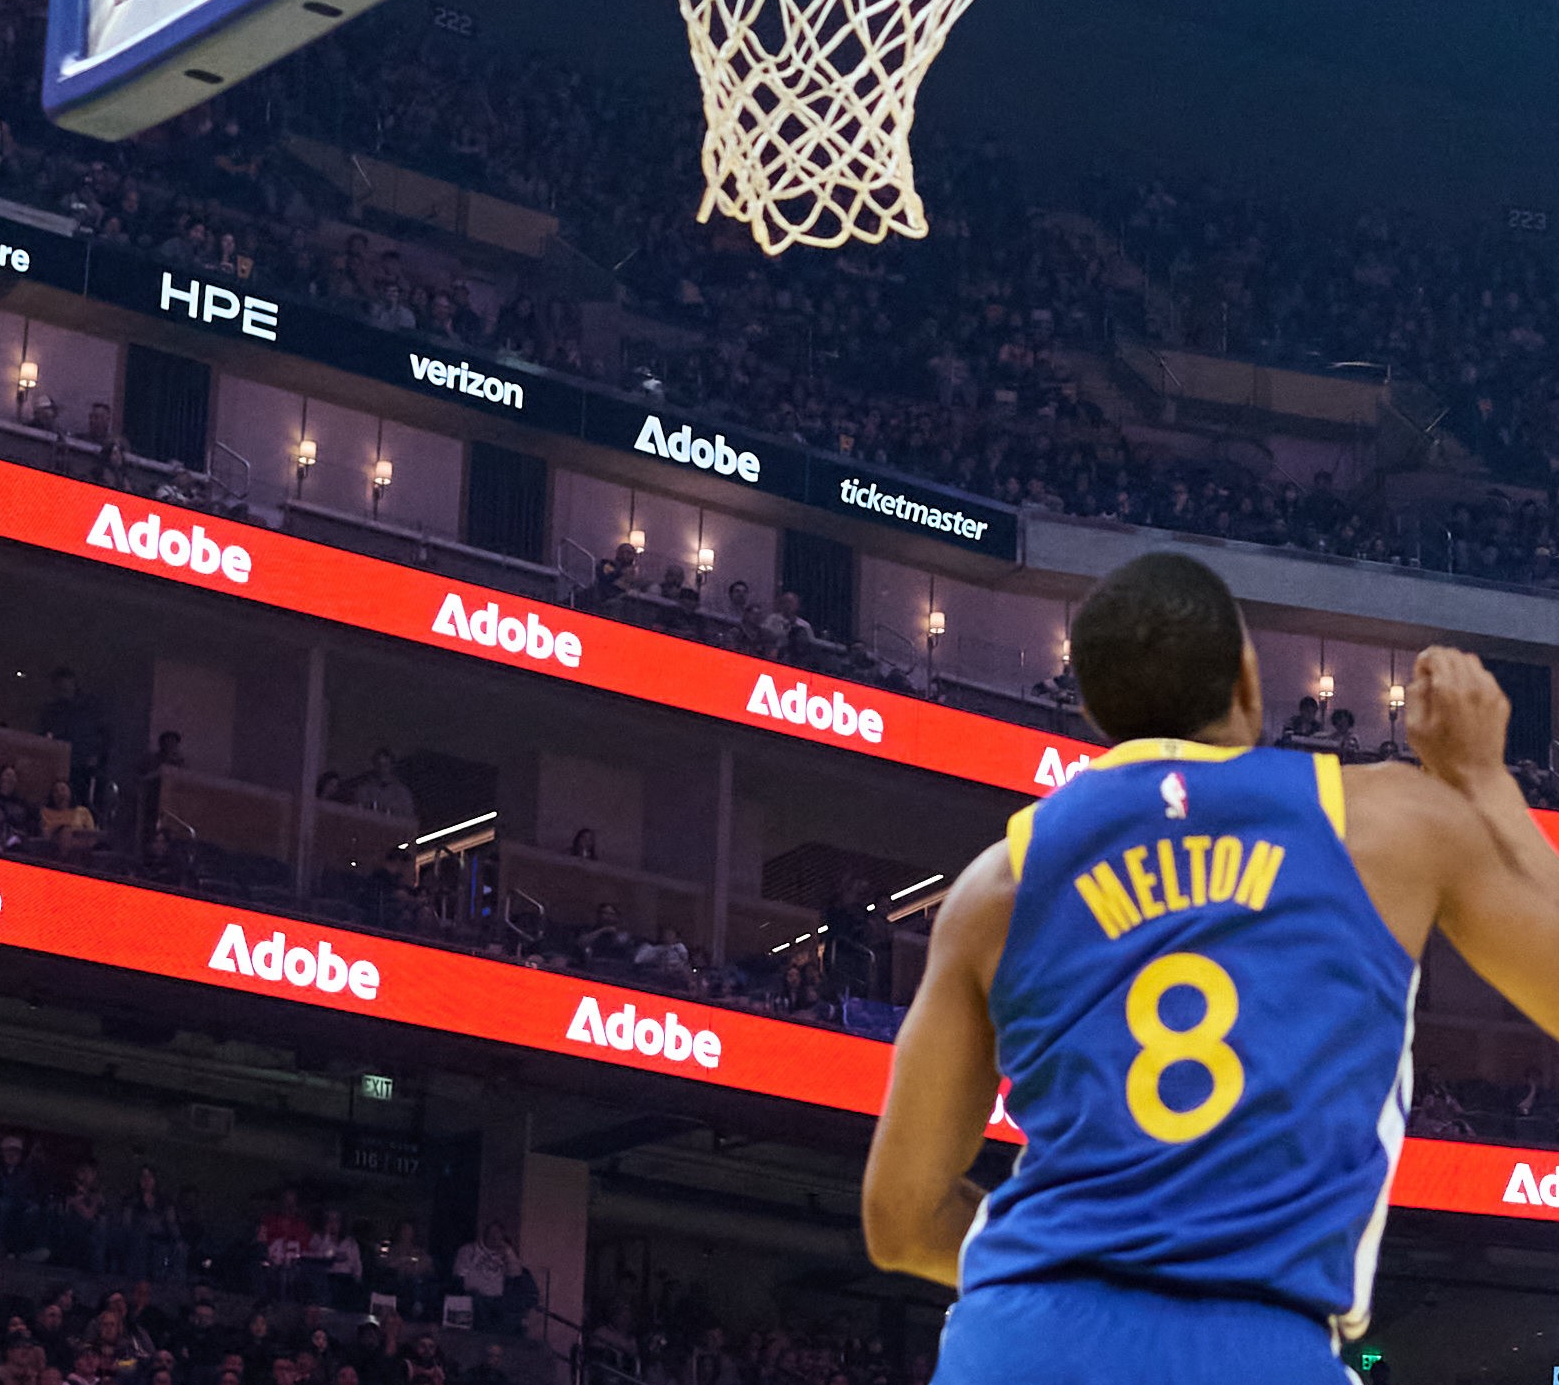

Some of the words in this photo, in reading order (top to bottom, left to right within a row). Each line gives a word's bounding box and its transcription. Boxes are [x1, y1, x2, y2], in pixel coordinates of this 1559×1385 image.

[160, 272, 279, 342] HPE
[409, 353, 524, 410] verizon
[634, 415, 760, 482] Adobe
[86, 503, 252, 583] Adobe
[840, 477, 988, 542] ticketmaster
[431, 593, 583, 667] Adobe
[746, 674, 884, 743] Adobe
[1074, 835, 1285, 940] MELTON
[207, 923, 380, 1001] Adobe
[565, 996, 722, 1069] Adobe
[1125, 952, 1245, 1143] 8
[364, 1077, 393, 1097] EXIT
